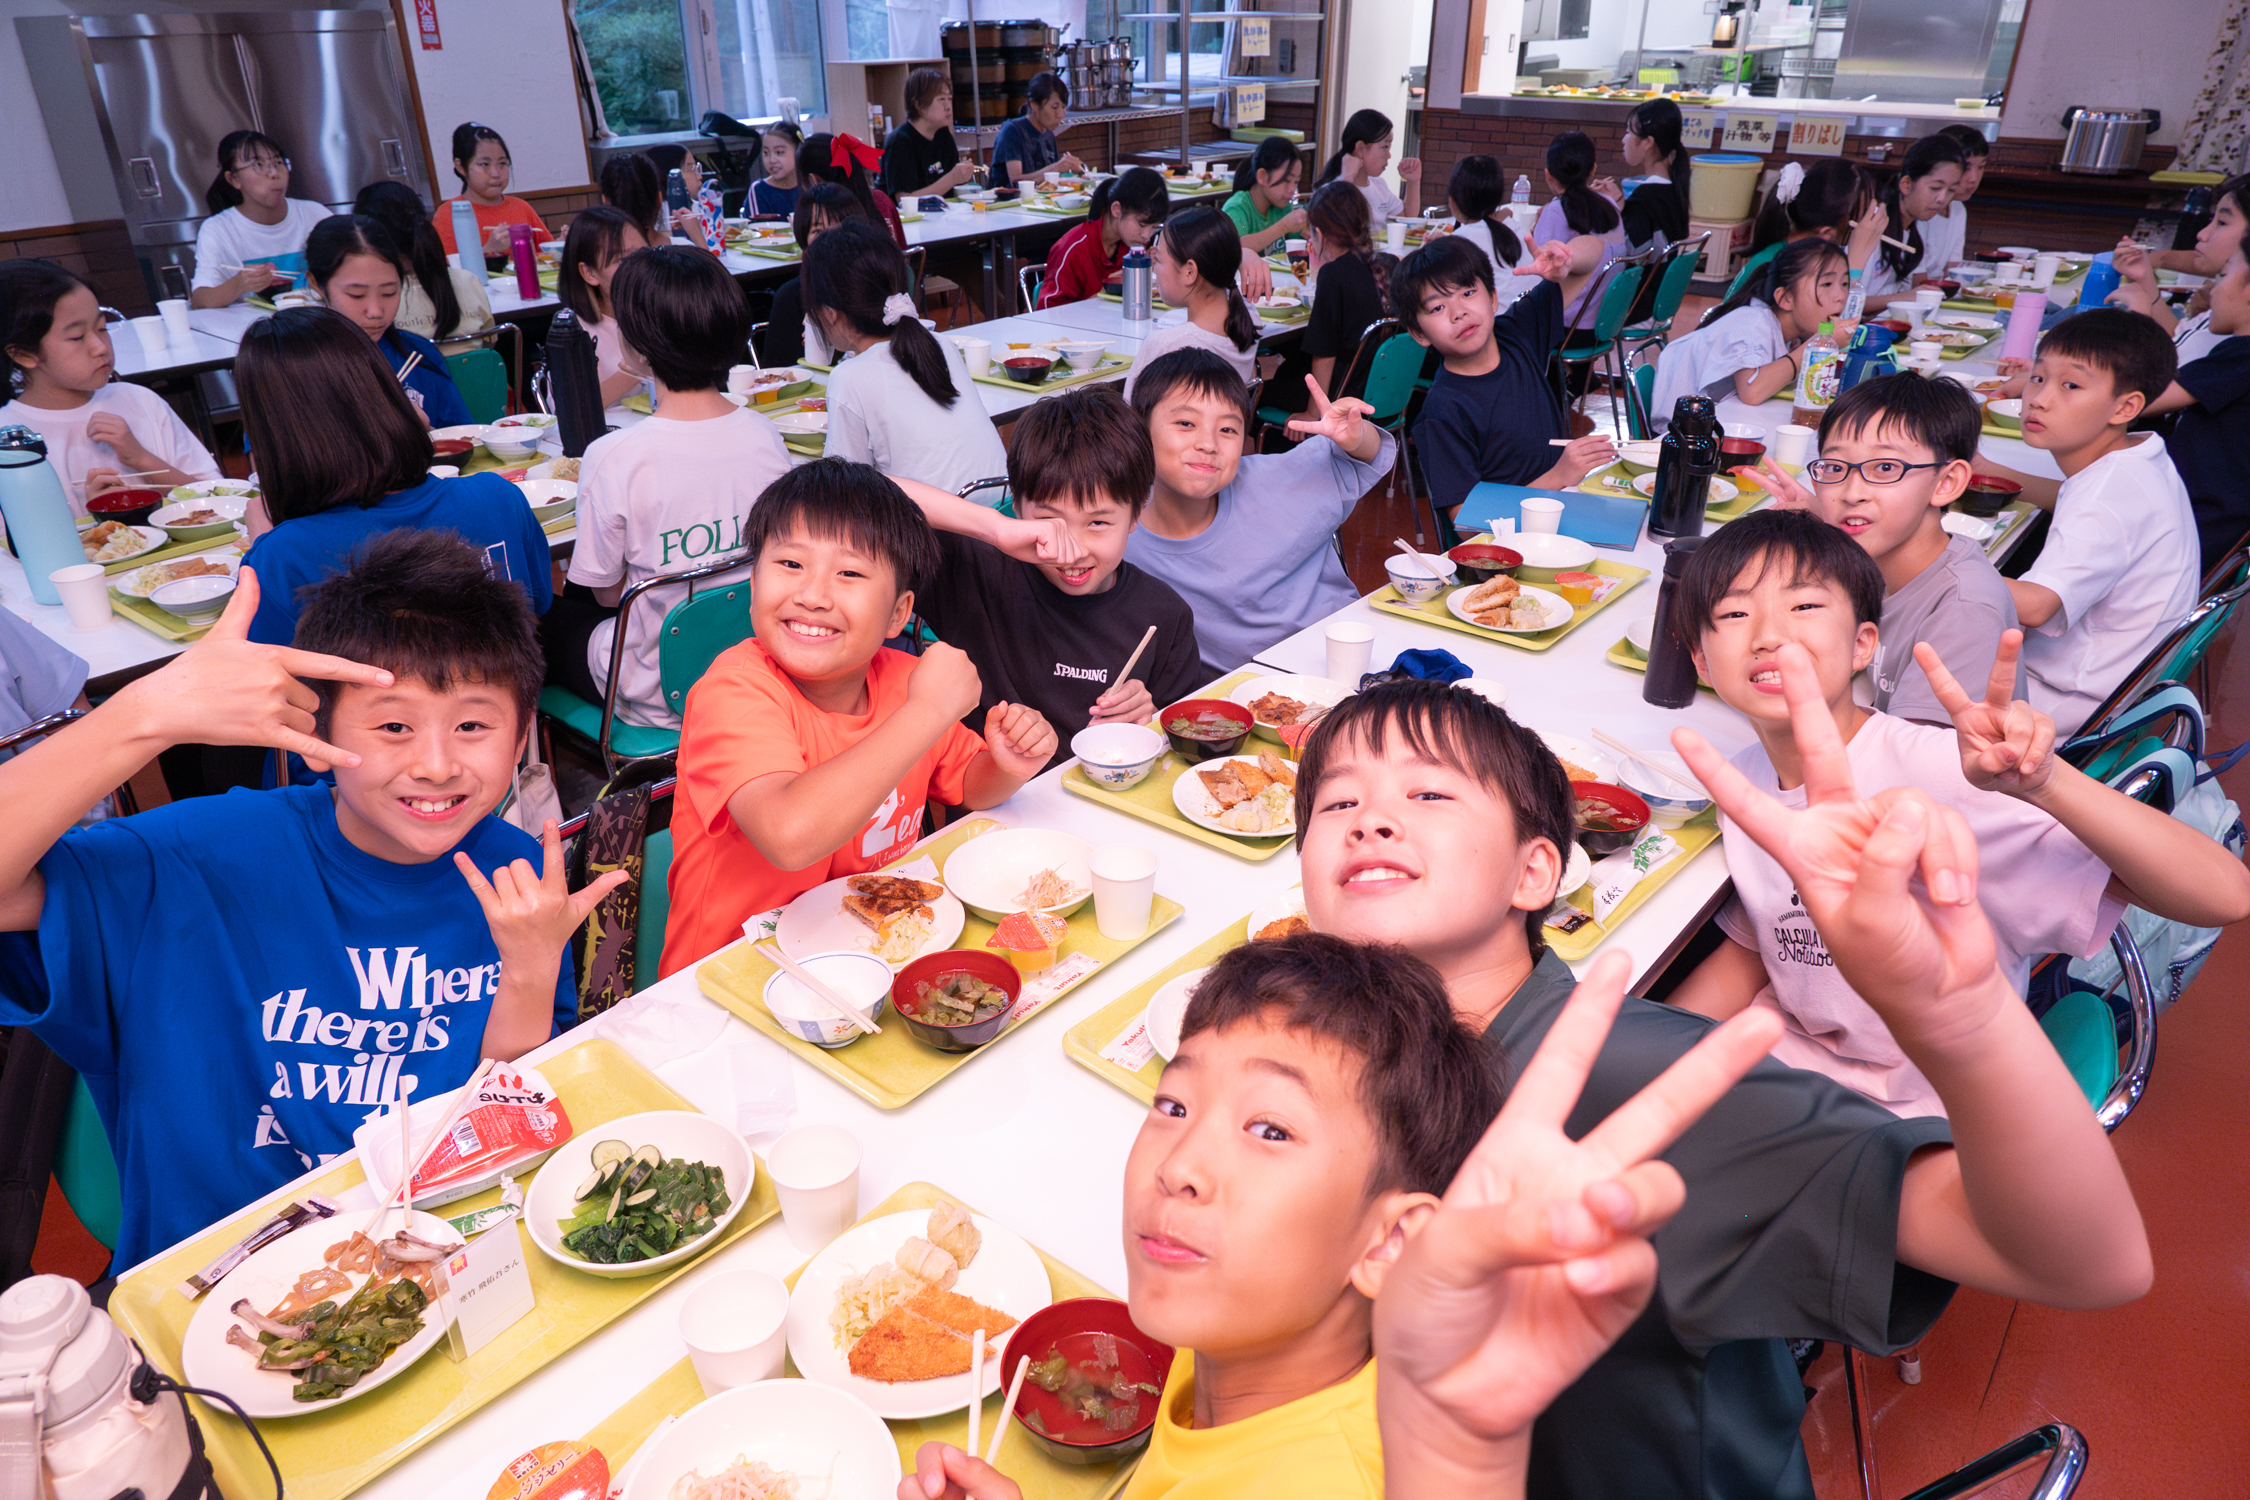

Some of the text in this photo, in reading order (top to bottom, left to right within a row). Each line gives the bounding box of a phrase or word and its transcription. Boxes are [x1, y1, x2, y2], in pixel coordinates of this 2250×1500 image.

[1792, 122, 1842, 145] 割りばし
[1053, 662, 1108, 684] SPALDING
[1778, 943, 1834, 967] Noteboo
[345, 946, 502, 1010] Where
[1053, 971, 1084, 991] Yakult
[261, 987, 450, 1053] there is
[269, 1061, 293, 1099] a
[516, 1461, 539, 1480] MEITO
